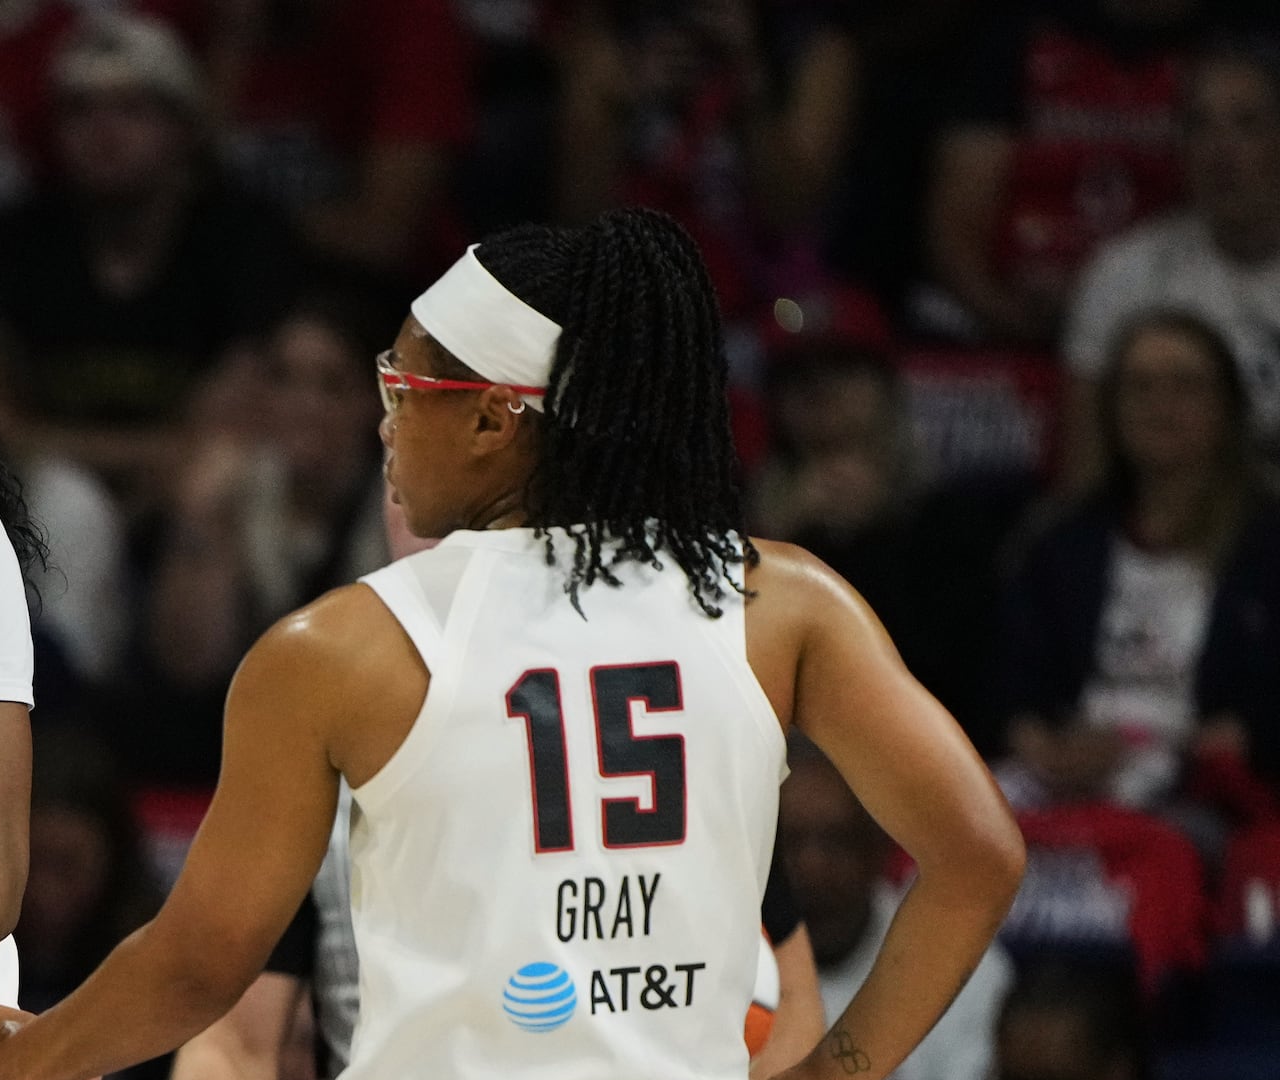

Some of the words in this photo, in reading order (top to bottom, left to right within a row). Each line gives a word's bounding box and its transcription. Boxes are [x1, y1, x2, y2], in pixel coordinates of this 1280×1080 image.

[505, 660, 687, 854] 15
[556, 873, 661, 943] GRAY
[591, 962, 706, 1015] AT&T
